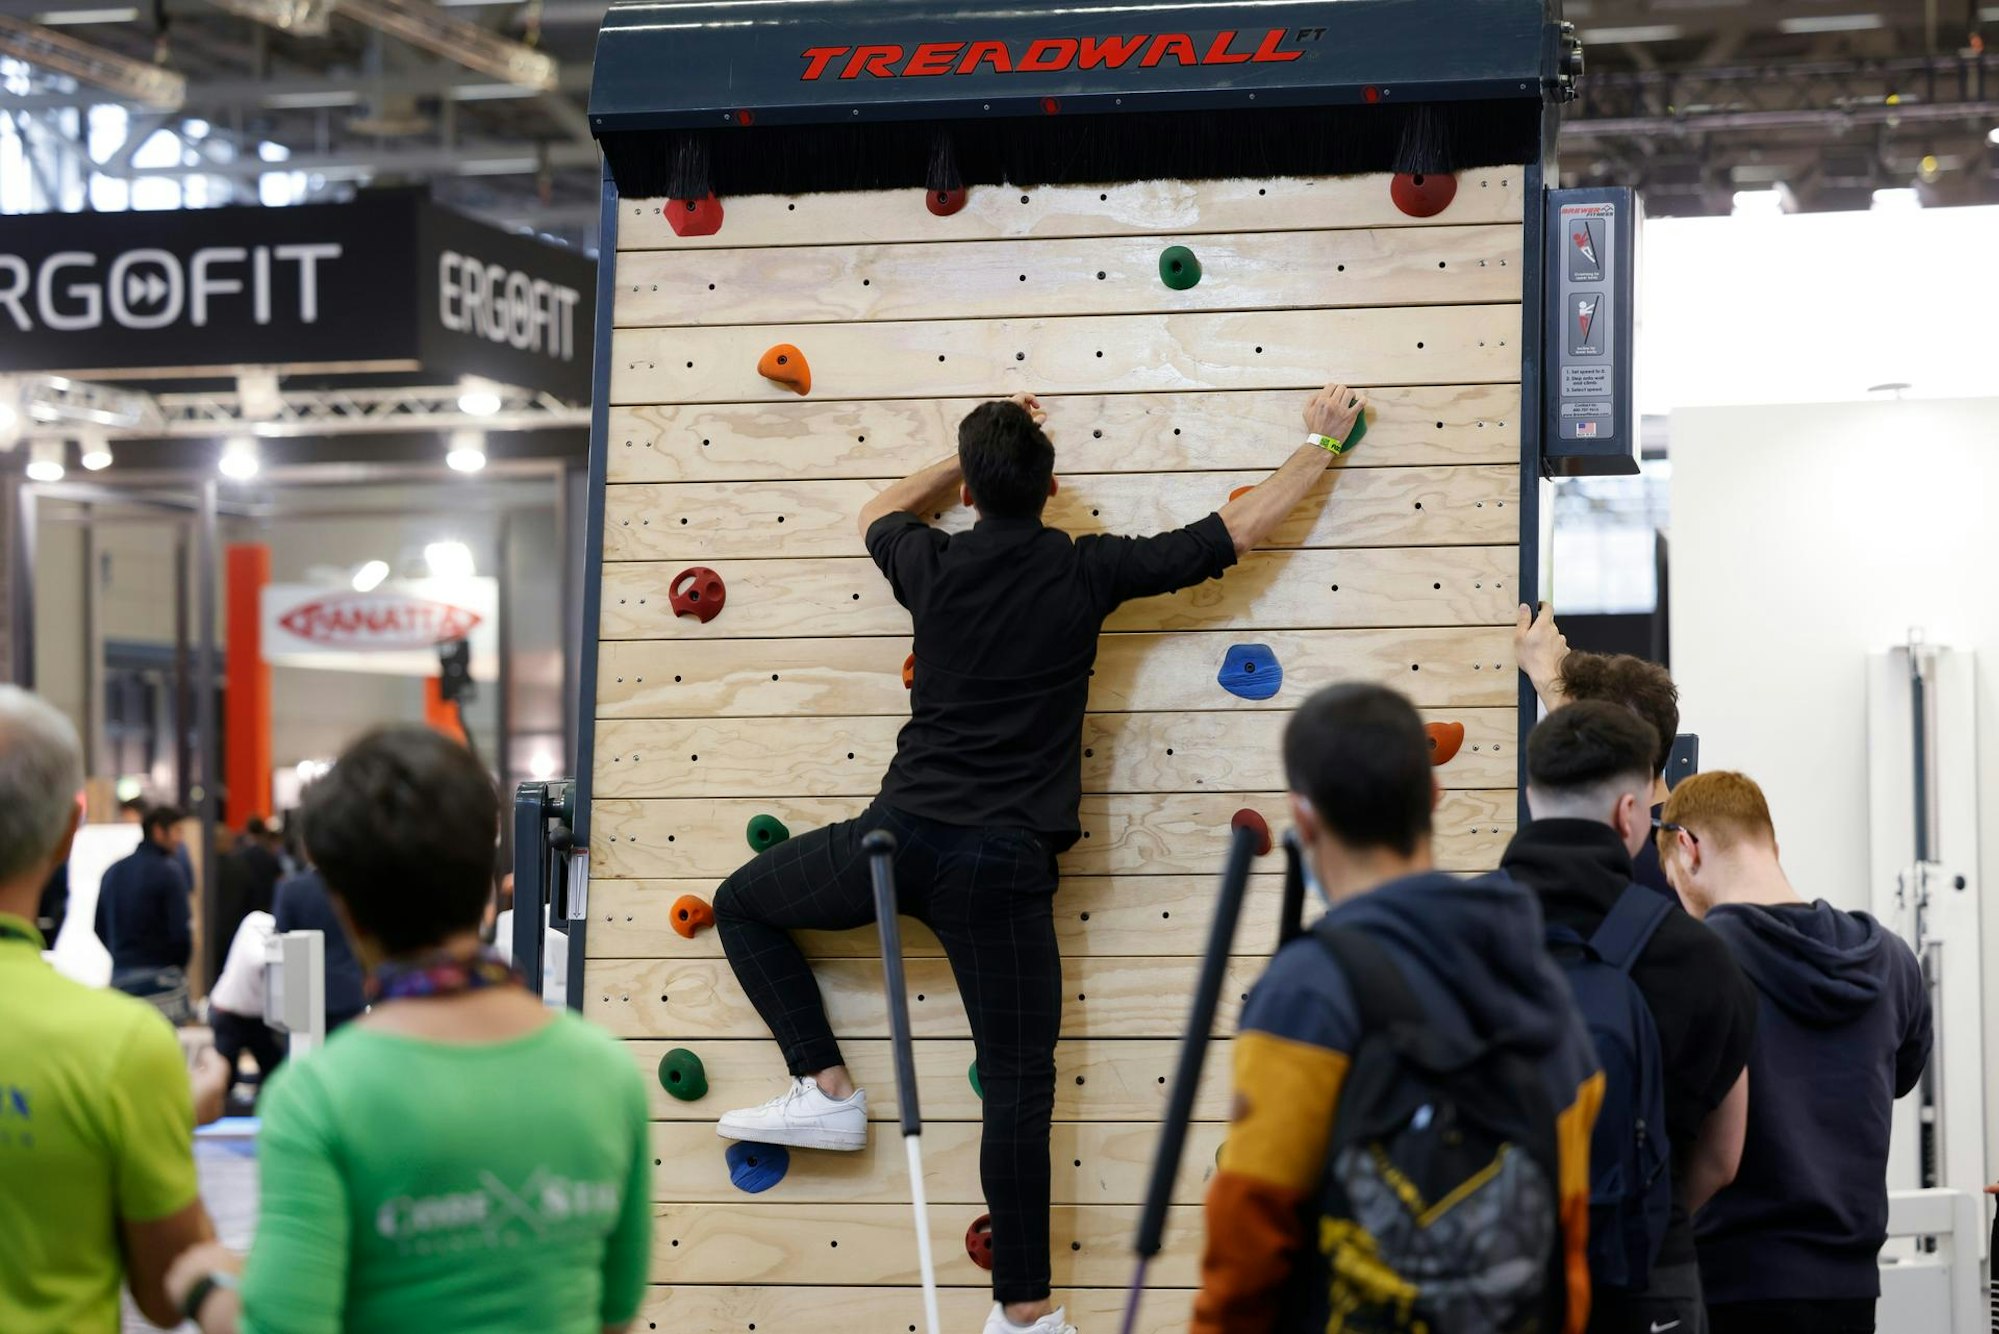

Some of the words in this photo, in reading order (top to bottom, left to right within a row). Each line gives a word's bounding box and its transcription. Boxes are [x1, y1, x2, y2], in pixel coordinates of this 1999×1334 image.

[800, 28, 1307, 81] TREADWALL
[1296, 27, 1327, 42] FT
[0, 243, 342, 332] RGOFIT
[439, 250, 580, 362] ERGOFIT
